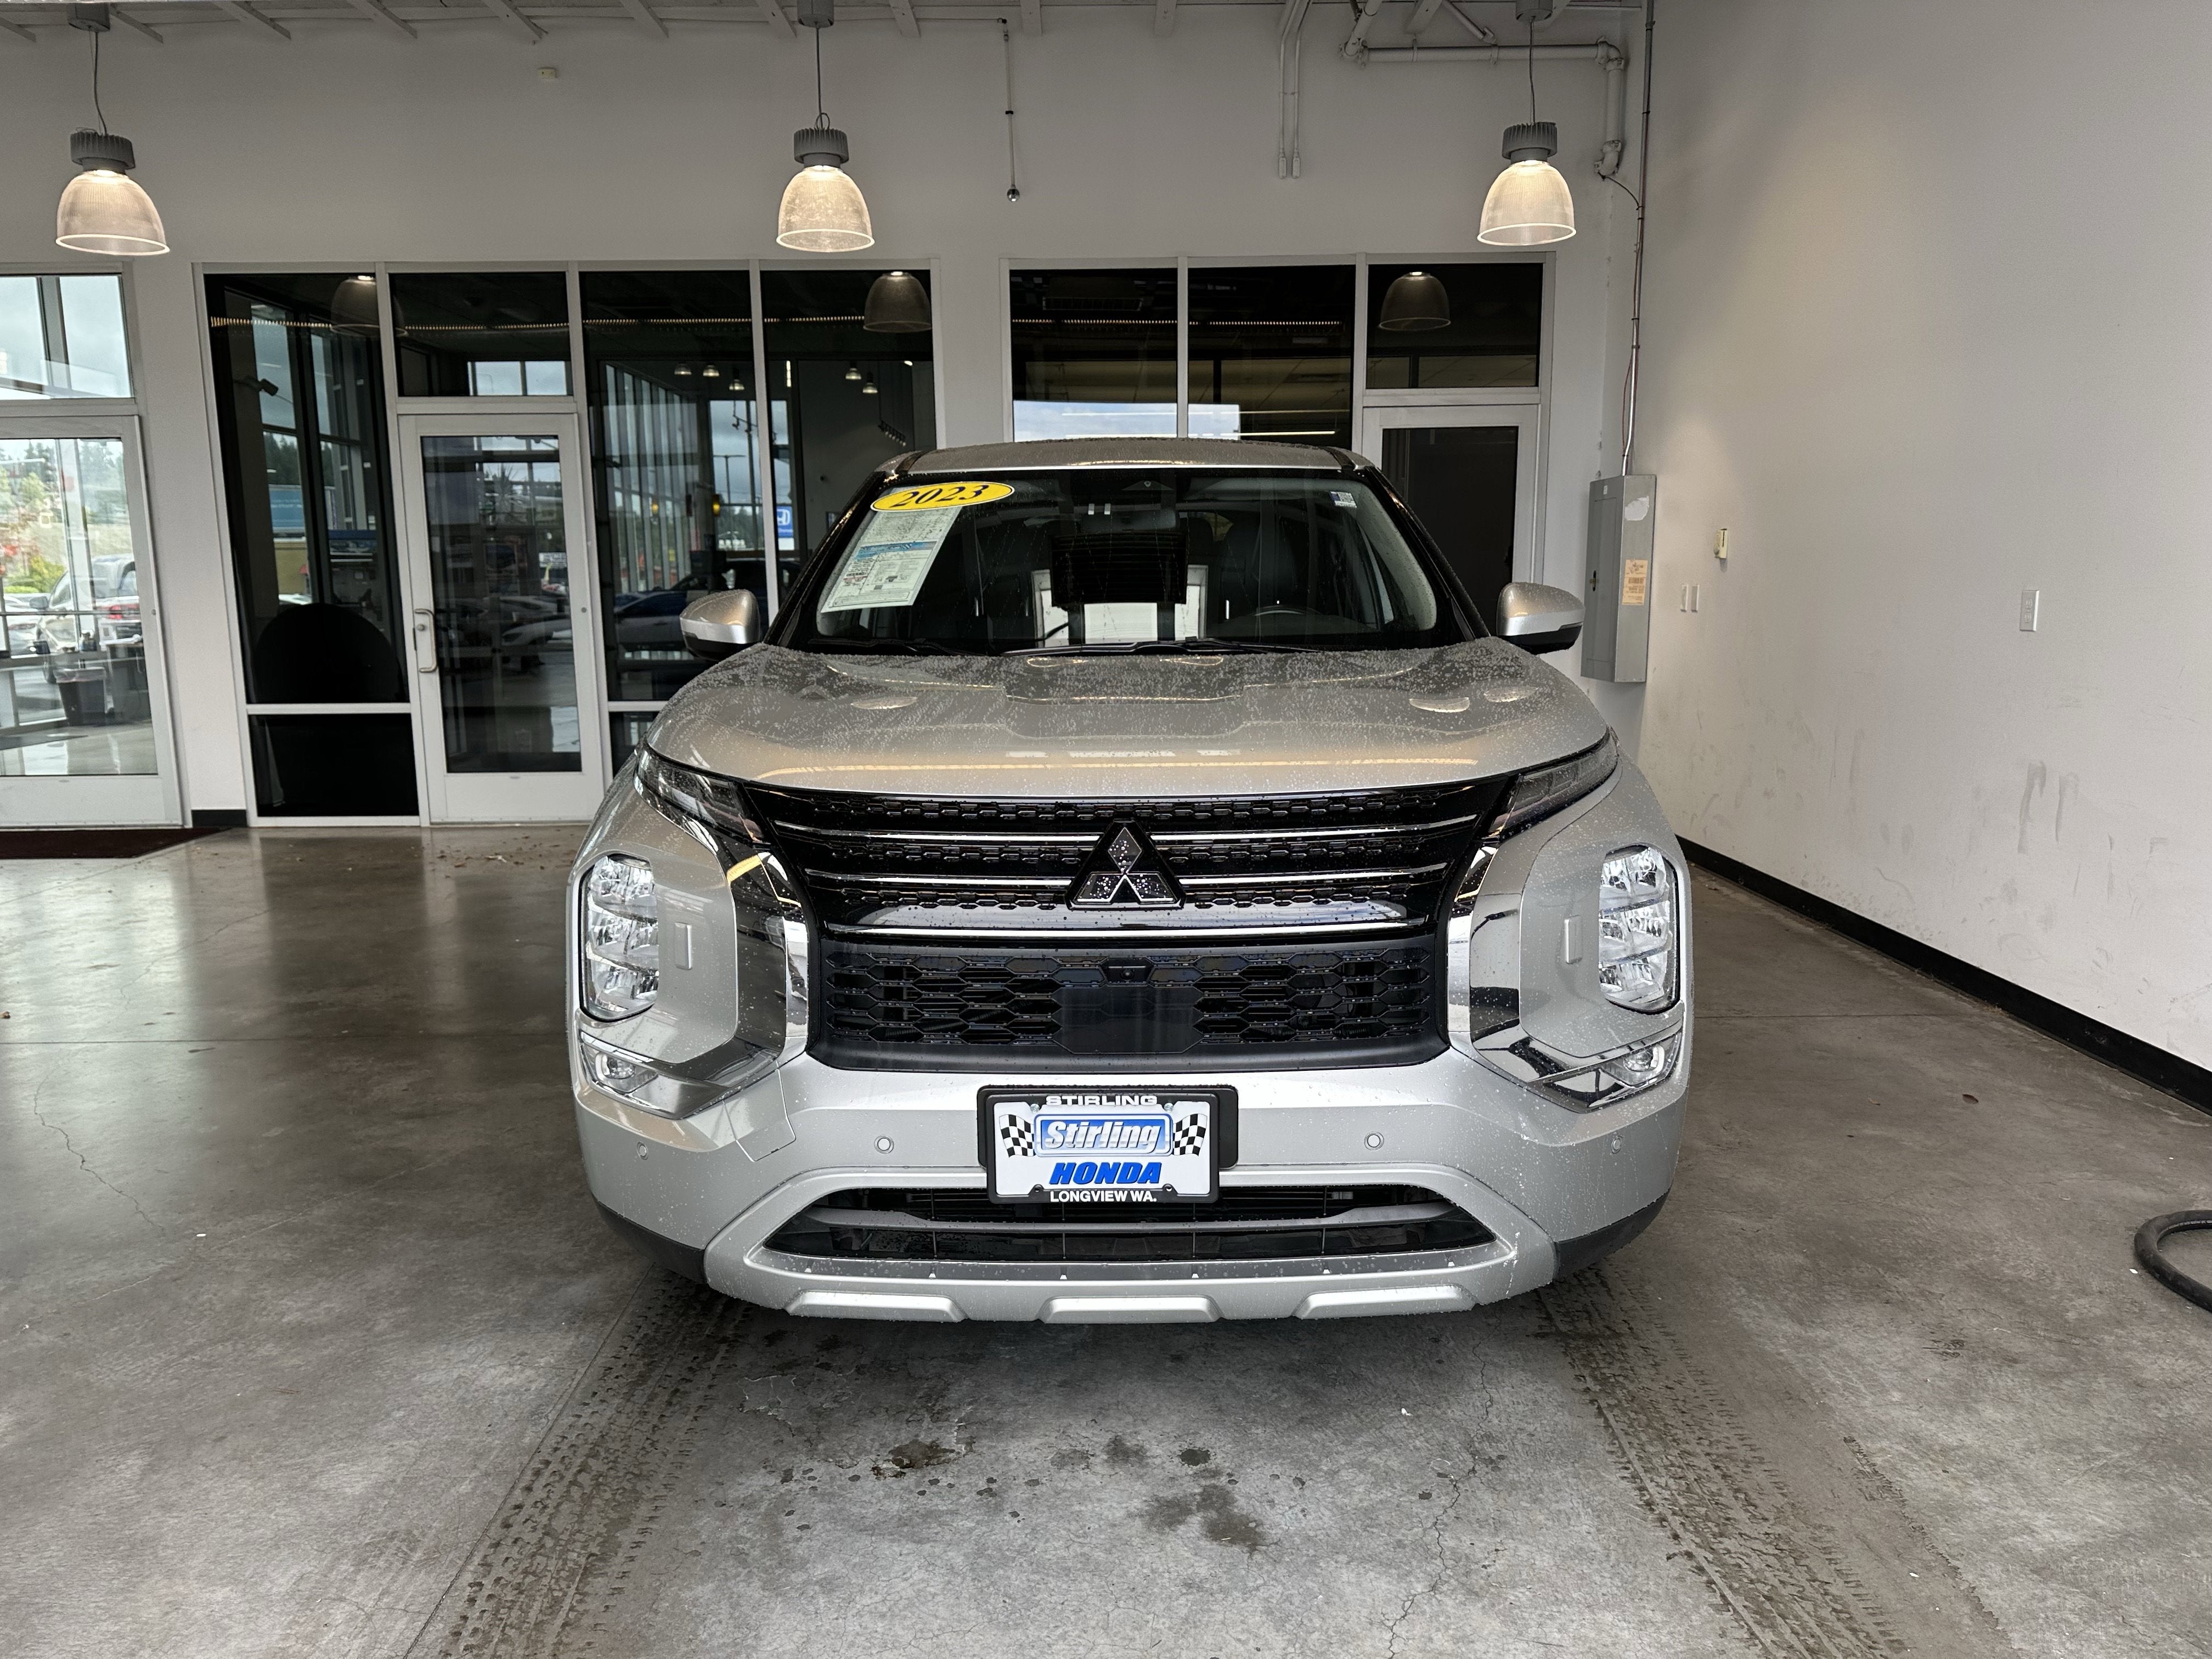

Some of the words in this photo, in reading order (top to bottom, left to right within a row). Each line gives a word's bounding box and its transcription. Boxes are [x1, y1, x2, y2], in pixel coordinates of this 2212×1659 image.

[890, 485, 989, 507] 2023
[1046, 1096, 1158, 1105] STIRLING
[1046, 1121, 1161, 1149] Stirling
[1049, 1162, 1162, 1184] HONDA
[1050, 1191, 1127, 1202] LONGVIEW
[1130, 1191, 1157, 1202] WA.
